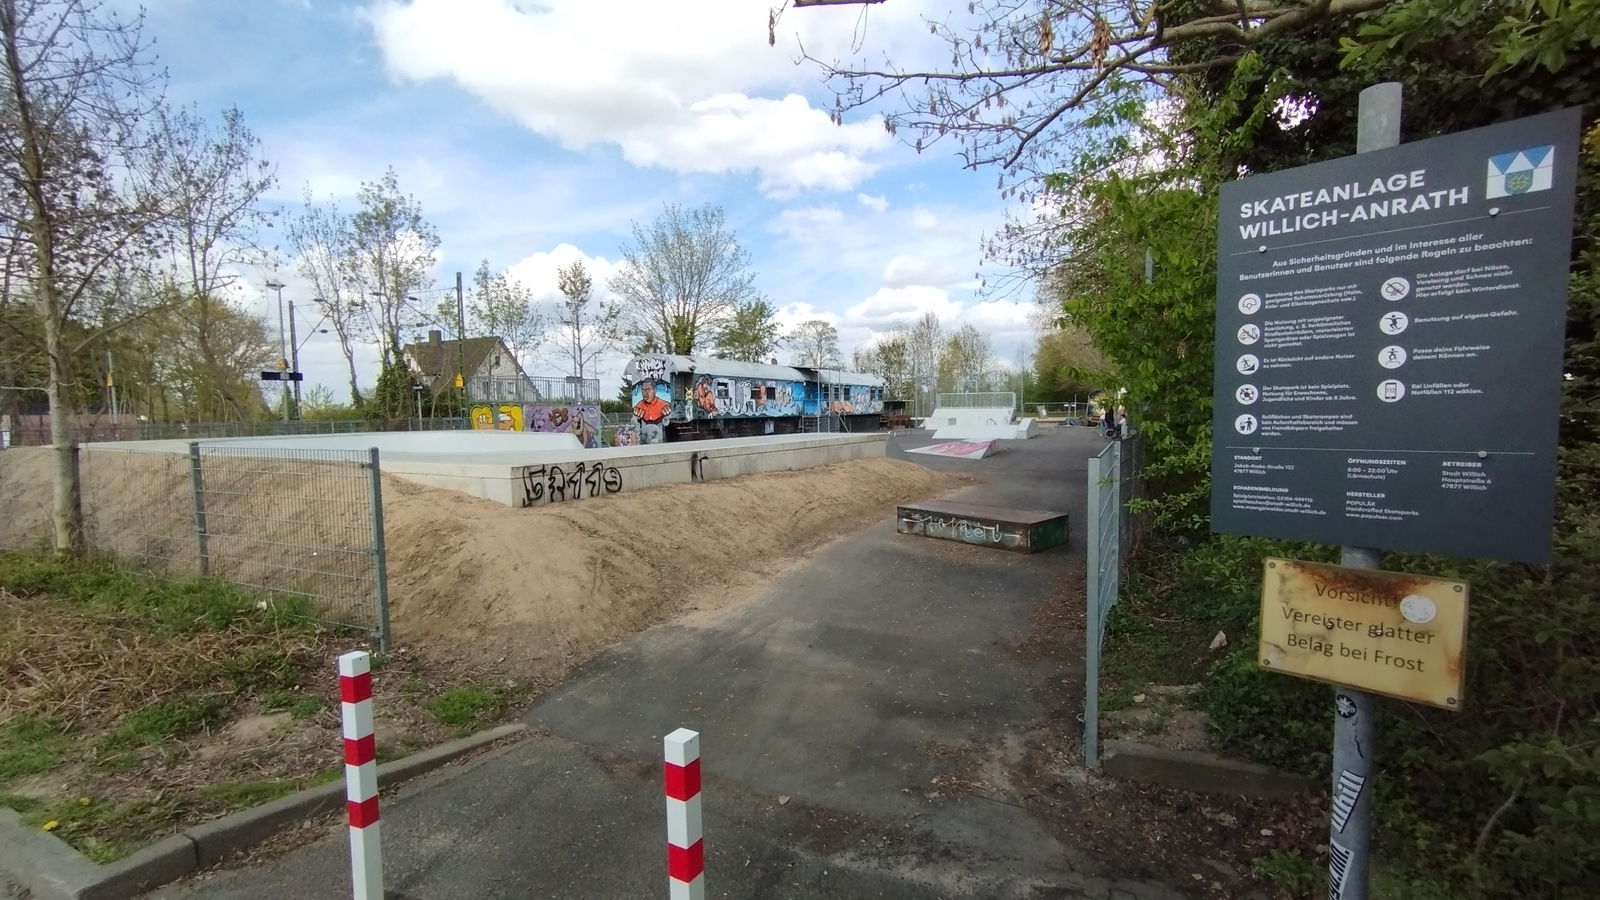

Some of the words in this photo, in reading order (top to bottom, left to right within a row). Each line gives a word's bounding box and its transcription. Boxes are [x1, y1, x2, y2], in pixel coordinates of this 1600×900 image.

[1239, 186, 1468, 239] WILLICH-ANRATH
[1240, 169, 1425, 218] SKATEANLAGE
[1239, 266, 1294, 281] Benutzerinnen
[1297, 265, 1311, 274] und
[1314, 259, 1352, 271] Benutzer
[1354, 256, 1373, 267] sind
[1376, 251, 1419, 264] folgende
[1422, 246, 1456, 259] Regeln
[1459, 244, 1471, 252] zu
[1474, 237, 1533, 250] beachten:
[1273, 259, 1286, 267] Aus
[1289, 248, 1373, 267] Sicherheitsgründen
[1374, 244, 1392, 254] und
[1395, 242, 1407, 252] im
[1410, 236, 1456, 250] Interesse
[1458, 233, 1483, 243] aller
[1416, 284, 1441, 293] genutzt
[1472, 283, 1521, 292] Winterdienst.
[1384, 508, 1419, 516] Skateparks
[1282, 606, 1363, 631] Vereister
[1367, 622, 1435, 645] glatter
[1287, 634, 1334, 657] Belag
[1340, 642, 1367, 661] bei
[1374, 650, 1424, 673] Frost
